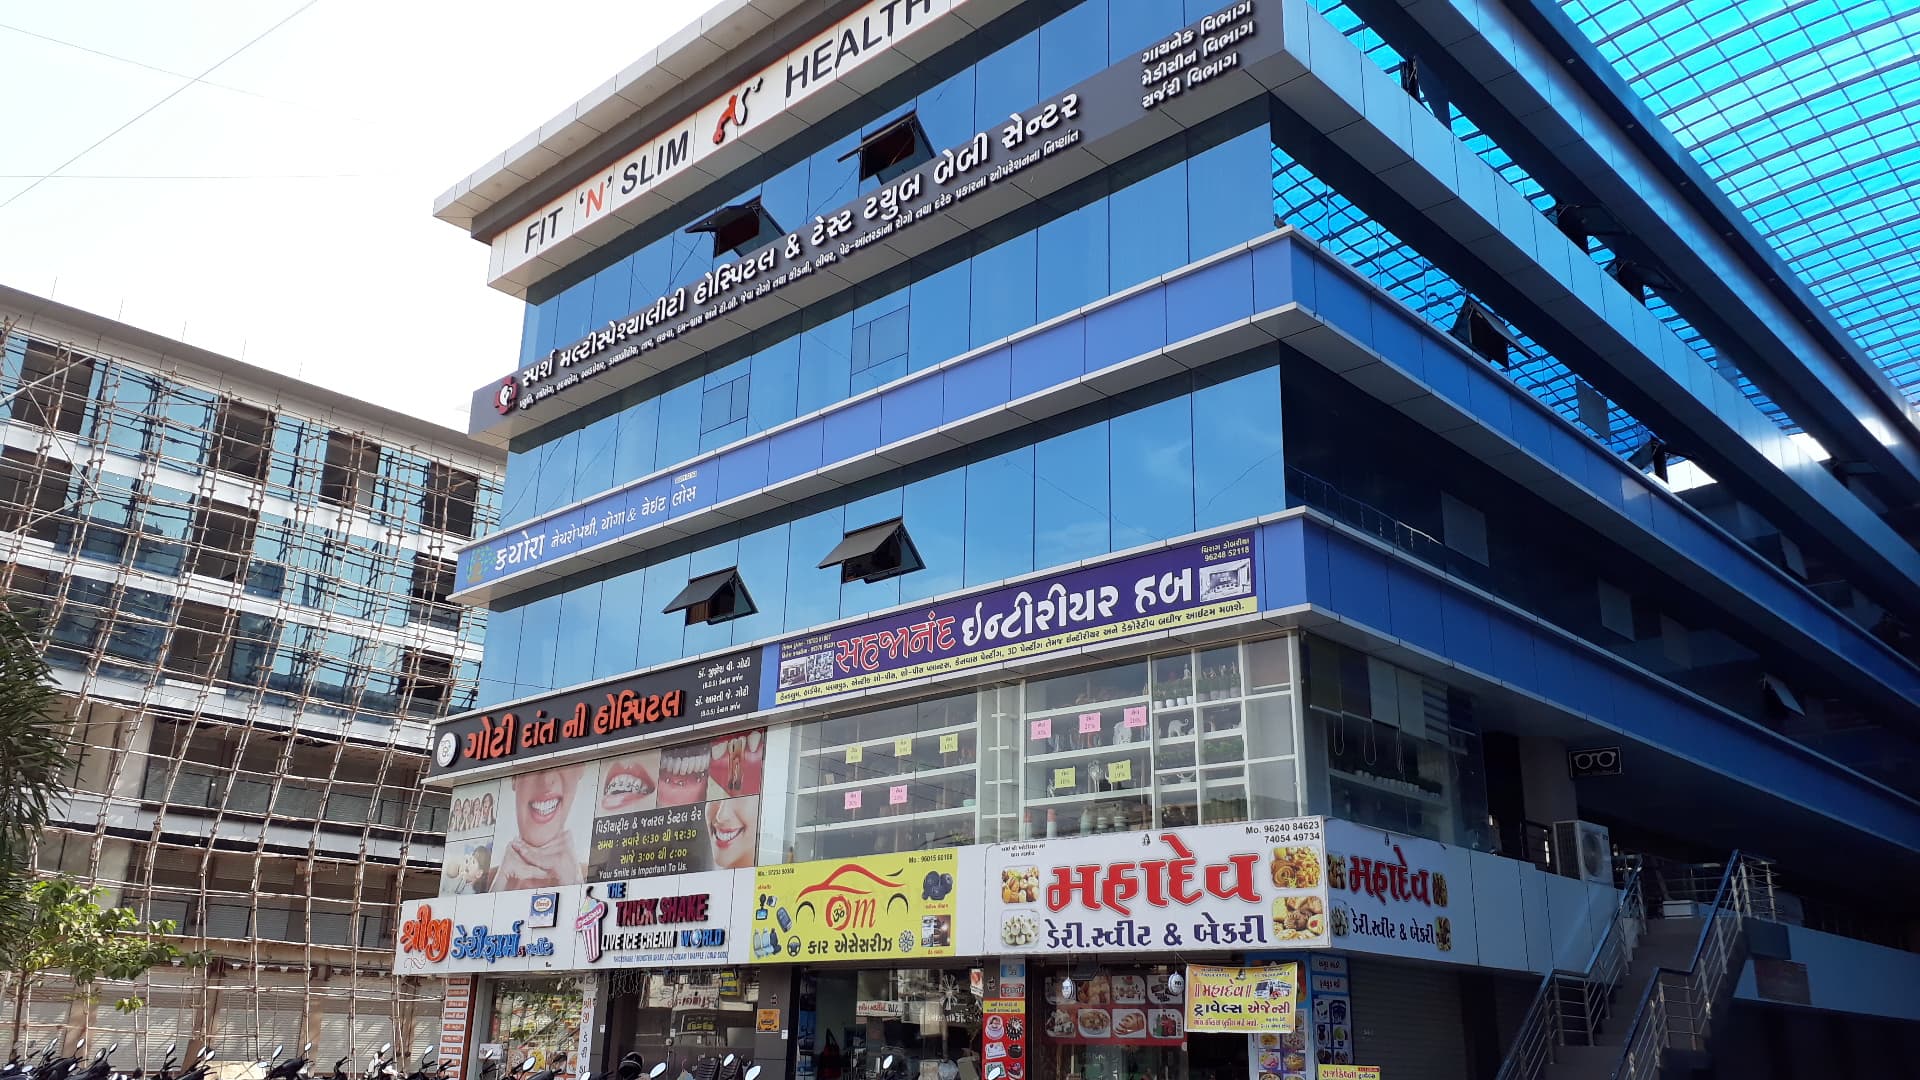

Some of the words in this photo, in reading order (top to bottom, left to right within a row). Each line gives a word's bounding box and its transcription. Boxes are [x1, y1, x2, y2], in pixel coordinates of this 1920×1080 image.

[1141, 31, 1195, 64] ગાયનેક
[1201, 1, 1251, 36] વિભાગ
[1141, 50, 1197, 86] મેડીસીન
[1203, 21, 1254, 57] વિભાગ
[1141, 77, 1181, 109] સર્જરી
[1187, 52, 1238, 88] વિભાગ
[525, 207, 564, 253] FIT
[622, 130, 689, 195] SLIM
[785, 0, 930, 97] HEALTH
[522, 348, 556, 387] સ્પર્શ
[693, 248, 775, 305] હોસ્પિટલ
[784, 234, 801, 259] &
[811, 210, 853, 246] ટેસ્ટ
[933, 133, 988, 185] બેબી
[1001, 93, 1078, 148] સેન્ટર
[755, 280, 772, 297] રોગો
[895, 211, 914, 229] રોગો
[915, 203, 932, 219] તથા
[934, 193, 952, 210] દરેક
[955, 177, 987, 201] પ્રકારના
[601, 510, 626, 531] યોગા
[627, 507, 637, 522] &
[672, 484, 697, 507] લોસ
[836, 610, 957, 674] સહજાનંદ
[1134, 567, 1193, 613] હબ
[1007, 646, 1018, 656] 3D
[1103, 623, 1118, 635] અને
[736, 656, 751, 669] ગોટી
[735, 684, 749, 698] ગોટી
[464, 713, 517, 760] ગોટી
[521, 709, 558, 748] દાંત
[562, 702, 588, 739] ની
[593, 689, 684, 734] હોસ્પિટલ
[690, 806, 702, 821] કેર
[1245, 826, 1262, 835] Mo.
[1263, 822, 1291, 833] 96240
[1292, 820, 1320, 831] 84623
[1264, 833, 1291, 844] 74054
[1293, 832, 1321, 842] 49734
[599, 869, 613, 880] Your
[613, 866, 630, 877] Smile
[638, 863, 667, 876] Important
[668, 863, 677, 872] To
[1046, 832, 1264, 917] મહાદેવ
[1349, 844, 1431, 906] મહાદેવ
[607, 882, 627, 899] THE
[616, 898, 659, 927] THICK
[659, 893, 710, 924] SHAKE
[401, 904, 453, 963] શ્રીજી
[601, 933, 623, 951] LIVE
[623, 932, 641, 950] ICE
[641, 930, 678, 949] CREAM
[681, 928, 726, 948] WORLD
[807, 939, 829, 954] કાર
[834, 932, 893, 954] એસેસરીઝ
[1163, 922, 1183, 946] &
[1193, 911, 1268, 945] બેકરી
[1399, 923, 1407, 941] &
[1410, 918, 1436, 945] બેકરી
[1194, 1000, 1243, 1017] ટ્રાવેલ્સ
[1247, 1000, 1290, 1014] એજેન્સી
